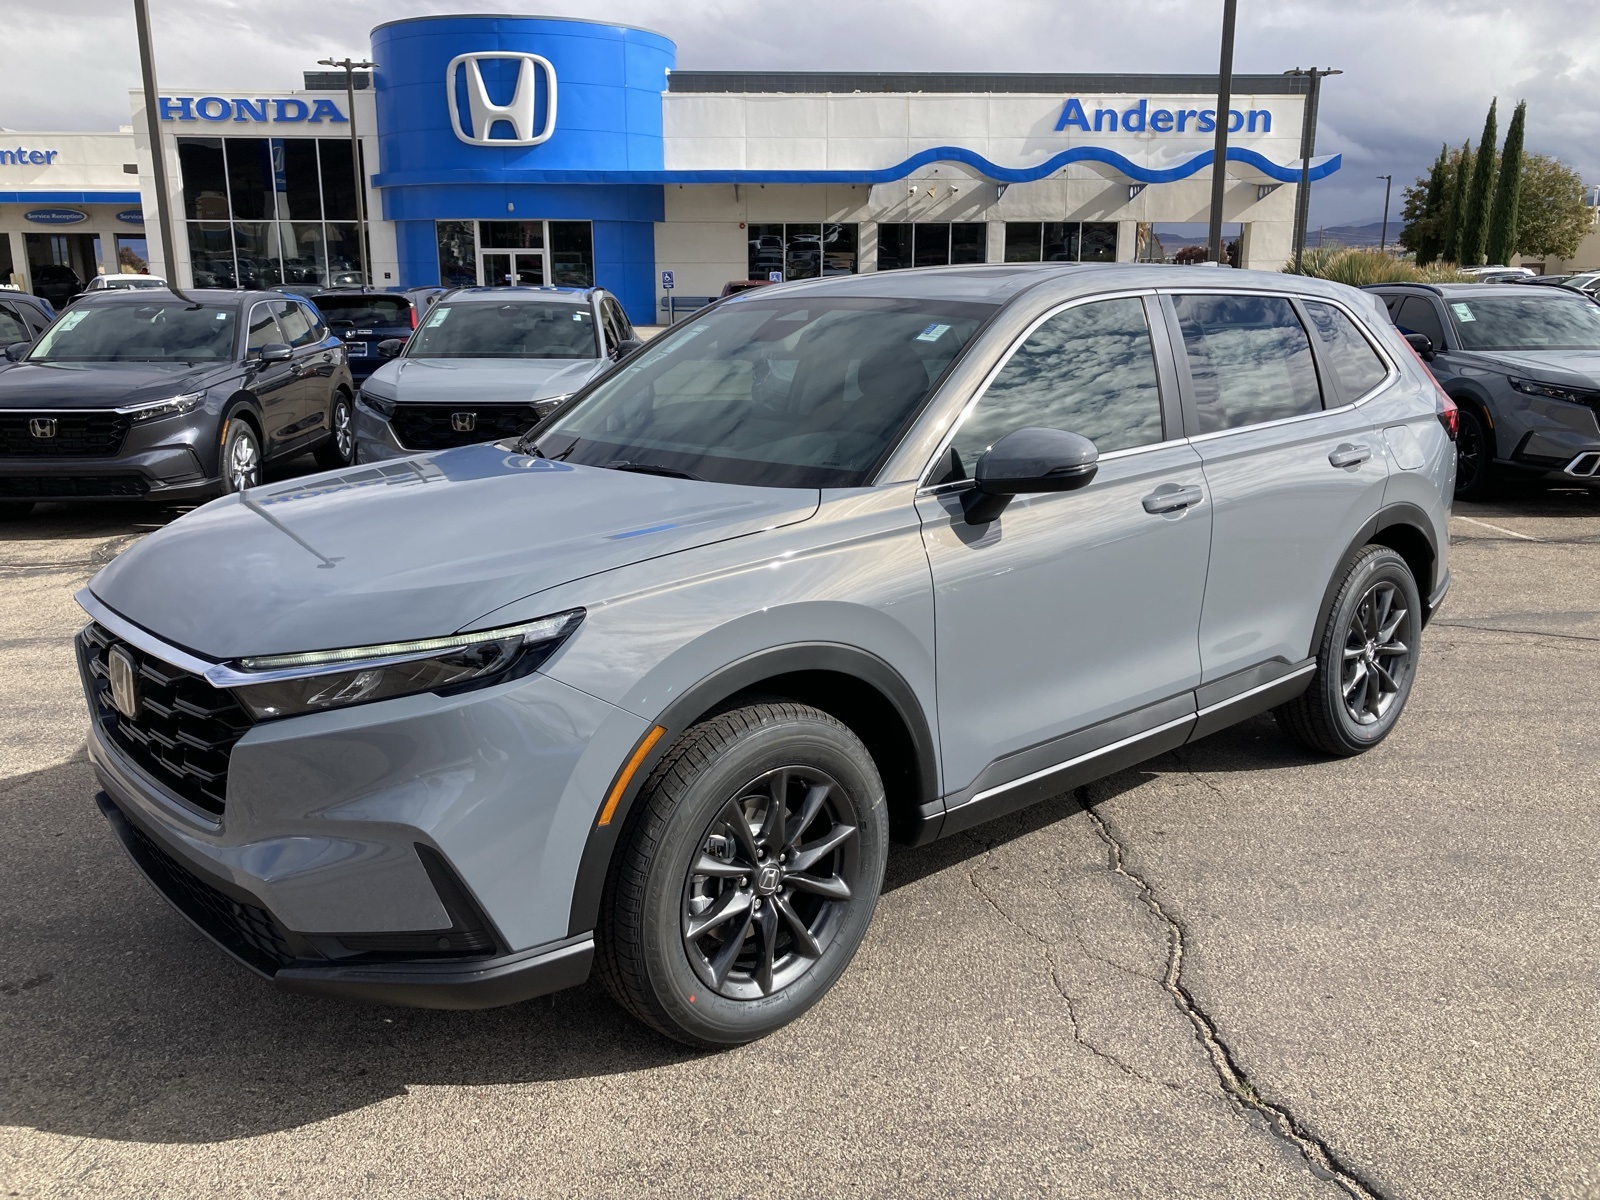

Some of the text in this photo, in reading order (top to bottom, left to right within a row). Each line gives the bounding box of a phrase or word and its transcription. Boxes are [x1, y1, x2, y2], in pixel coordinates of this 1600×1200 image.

[158, 96, 349, 123] HONDA
[1054, 98, 1273, 133] Anderson
[0, 146, 58, 165] nter
[51, 213, 83, 221] Reception
